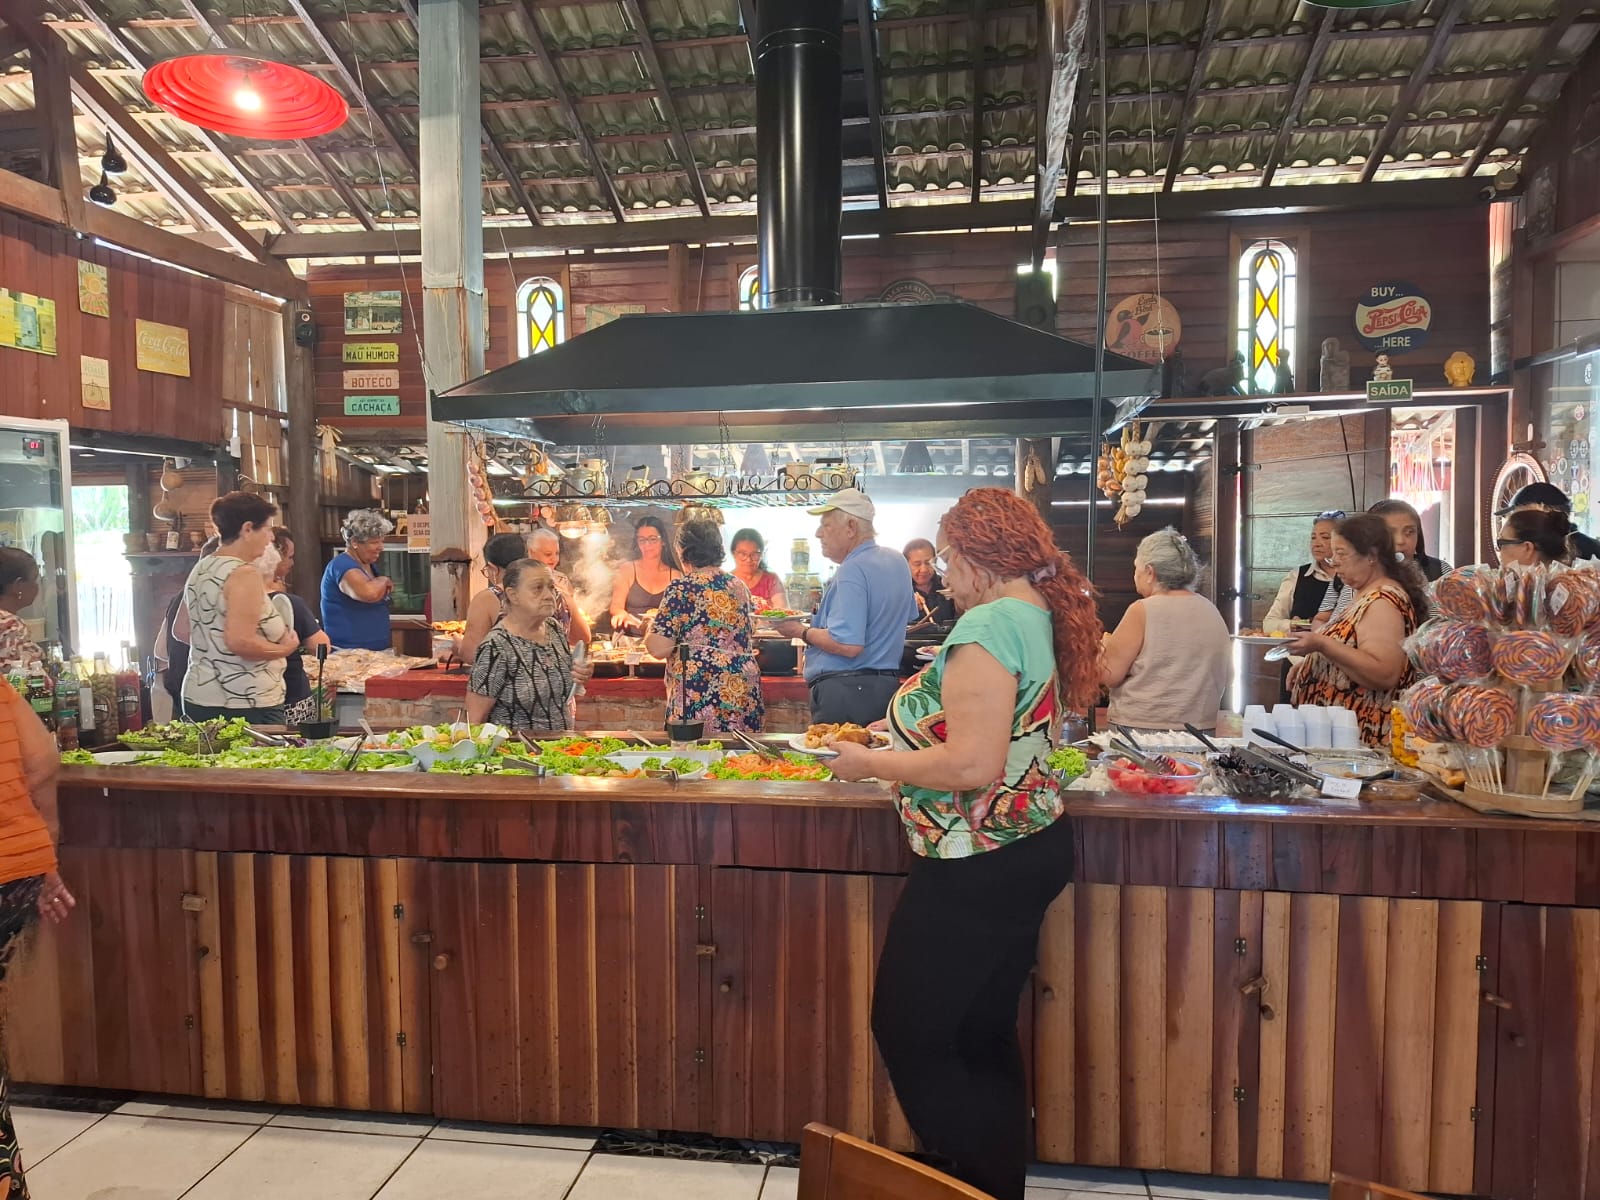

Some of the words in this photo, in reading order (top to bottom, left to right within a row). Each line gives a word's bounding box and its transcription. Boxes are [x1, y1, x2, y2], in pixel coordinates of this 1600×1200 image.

[345, 351, 363, 361] MAU
[366, 351, 395, 360] HUMOR
[351, 377, 392, 388] BOTECO
[1370, 383, 1409, 396] SAÍDA
[351, 403, 392, 414] CACHAÇA
